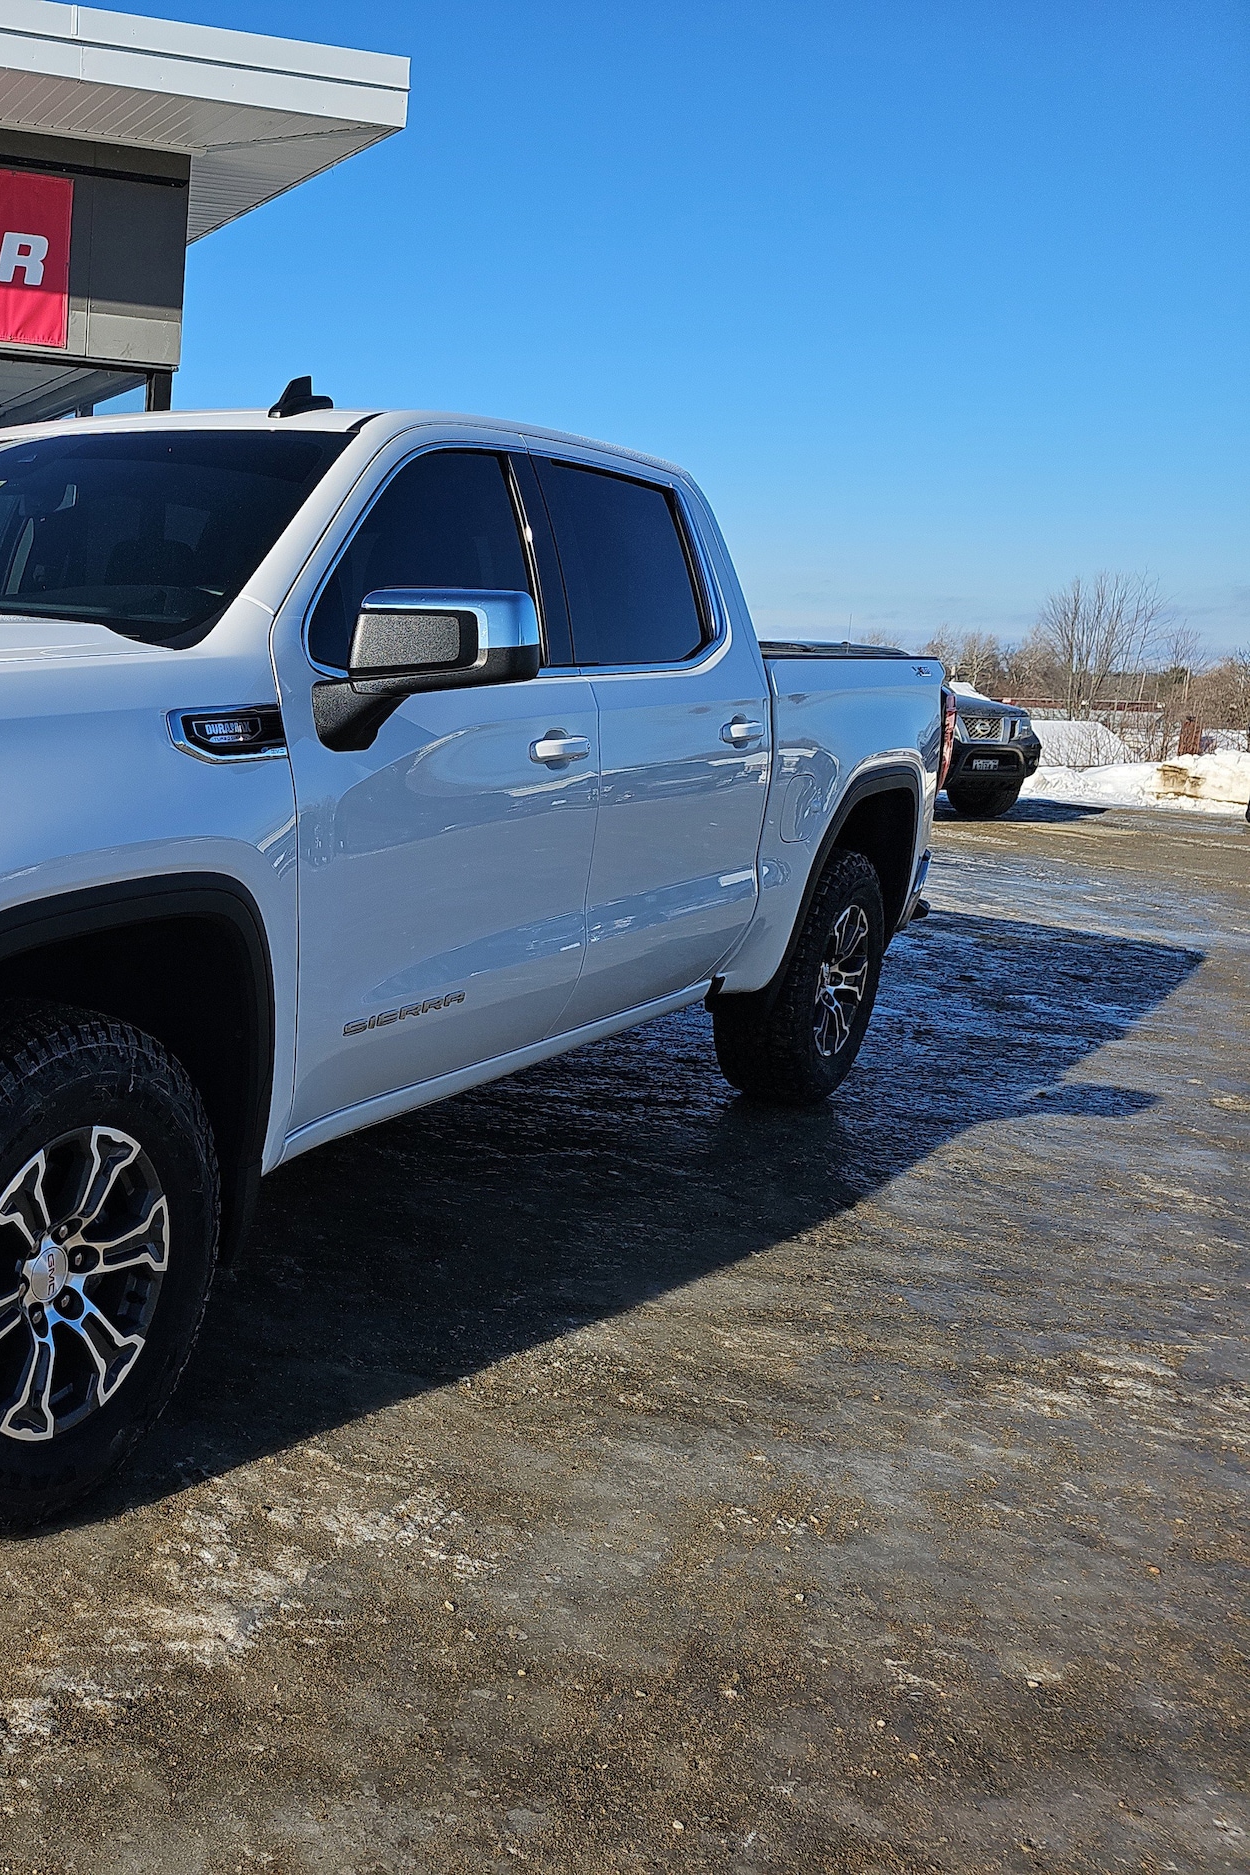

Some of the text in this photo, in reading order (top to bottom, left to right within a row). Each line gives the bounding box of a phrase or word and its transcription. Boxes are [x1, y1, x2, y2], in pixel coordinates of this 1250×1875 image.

[204, 721, 252, 736] DURAMAX
[342, 989, 467, 1038] SIERRA
[47, 1253, 55, 1296] GMC
